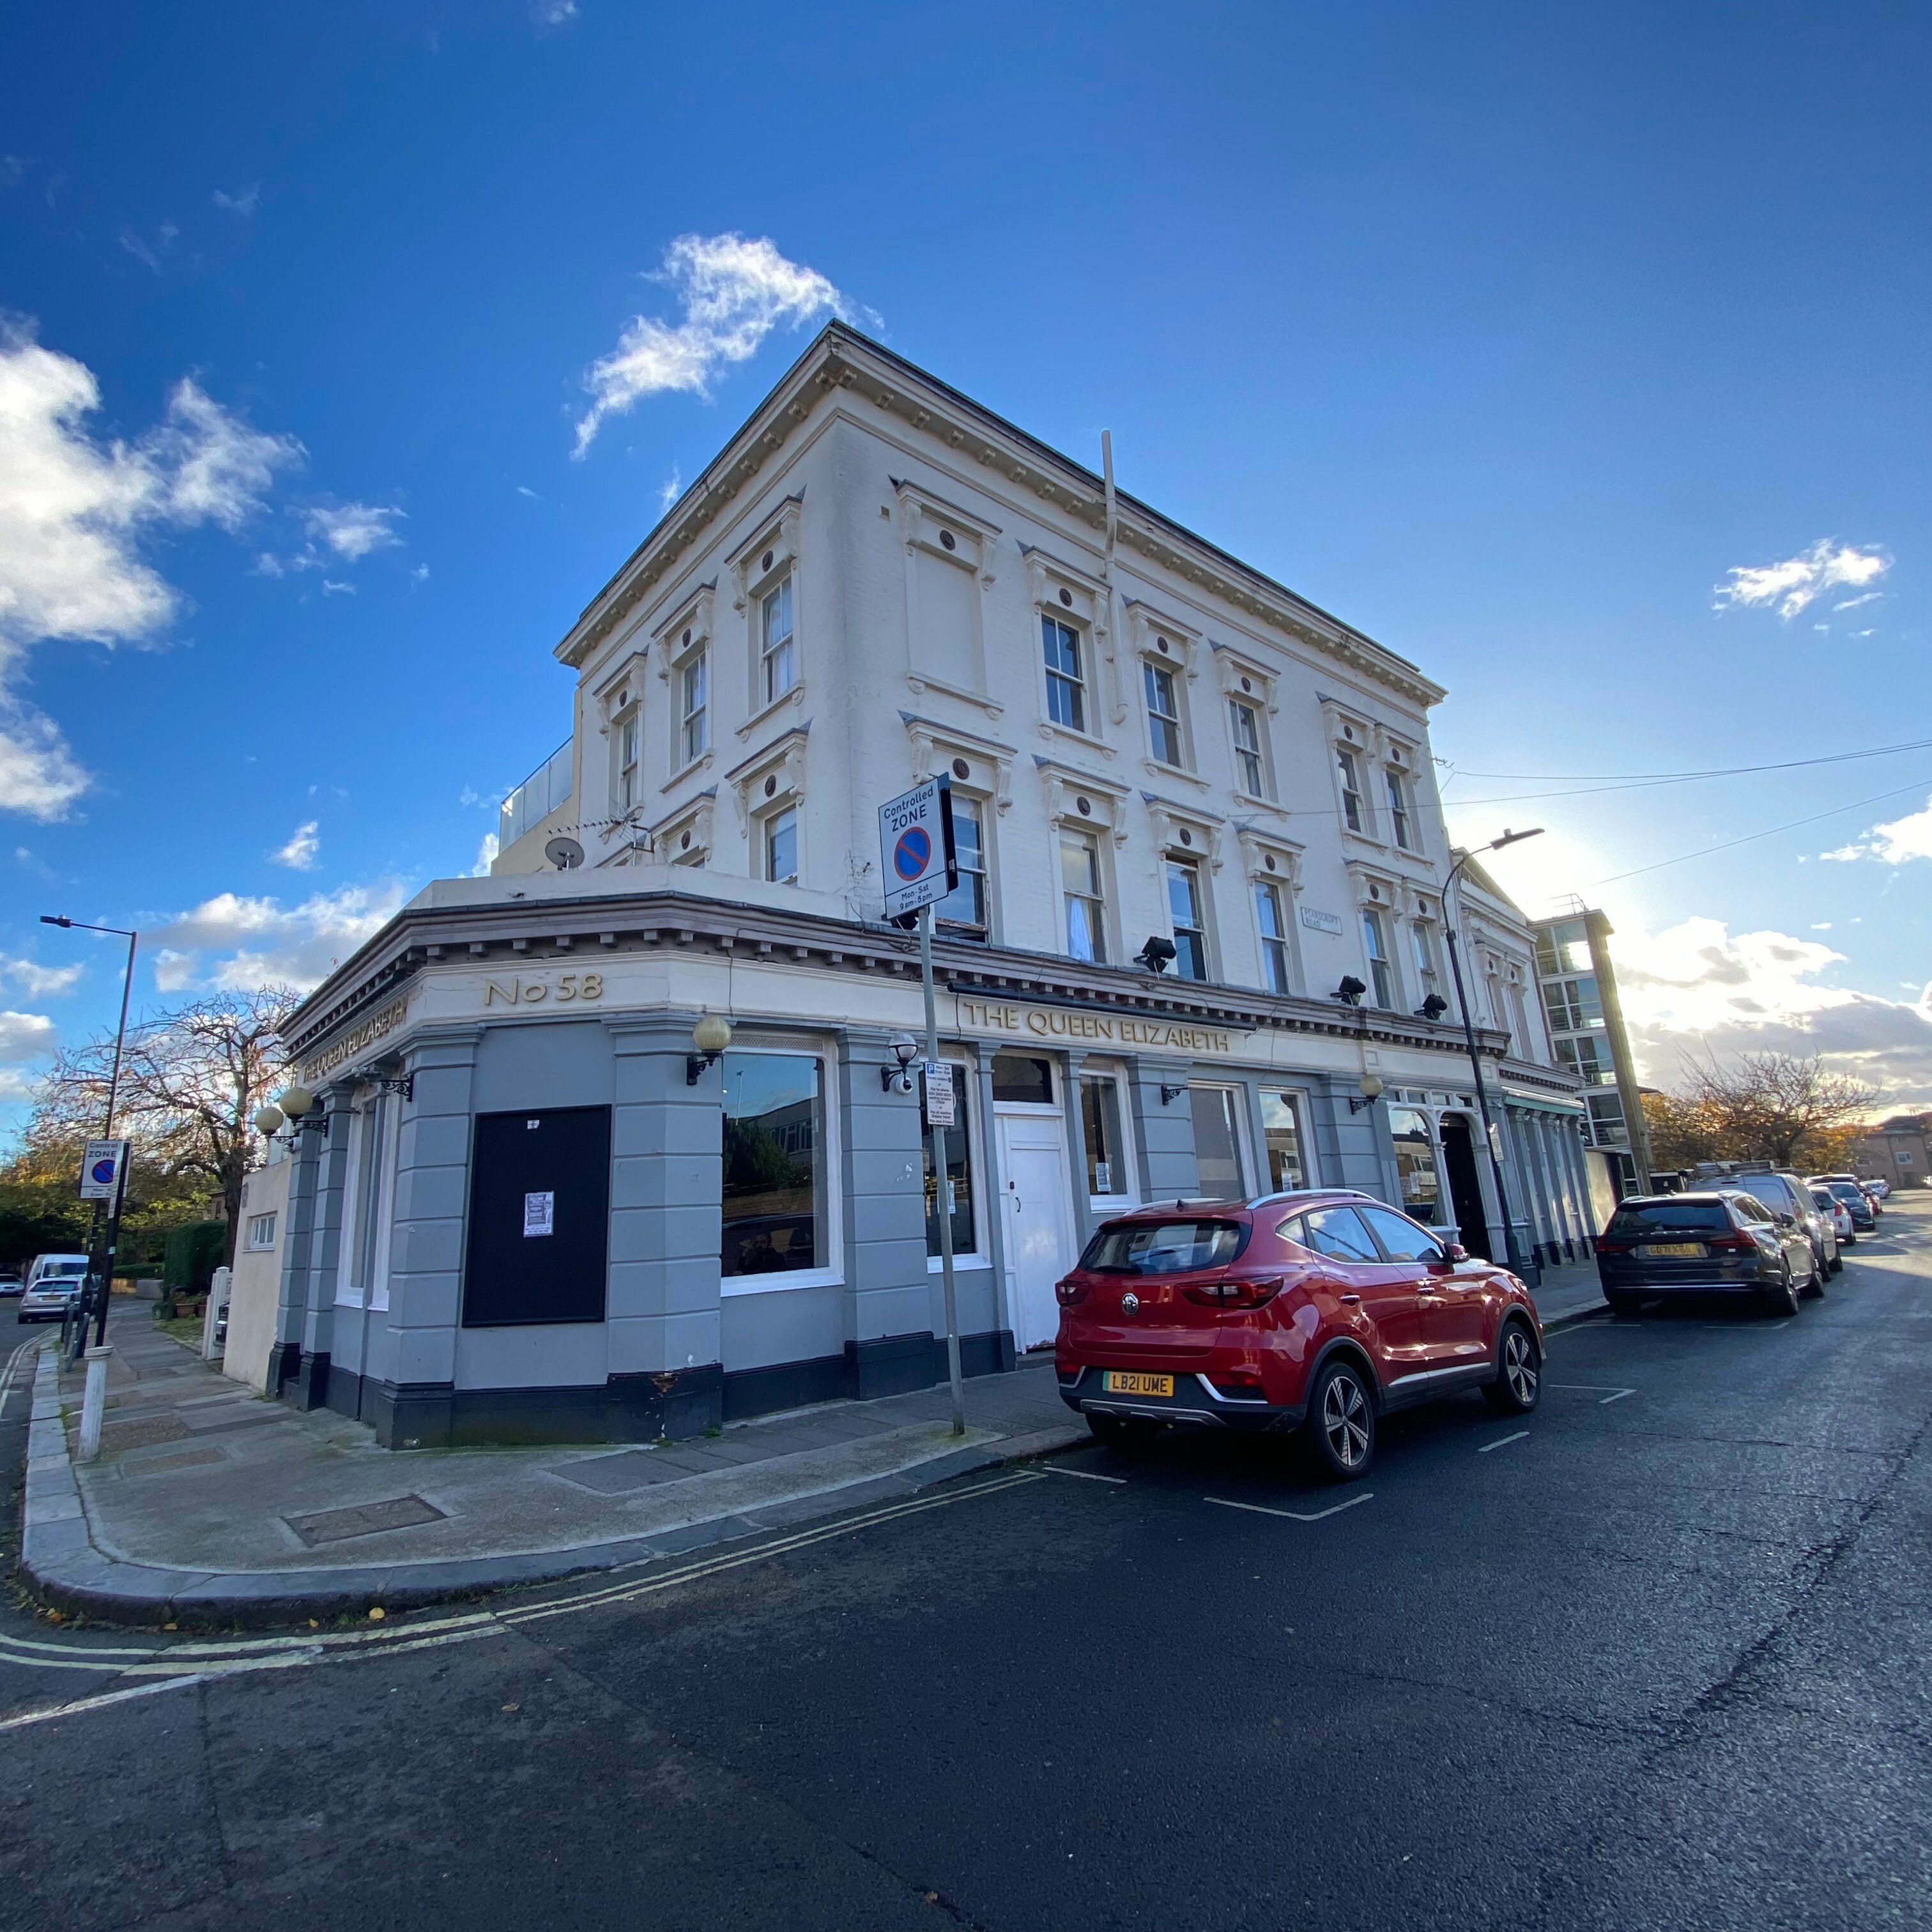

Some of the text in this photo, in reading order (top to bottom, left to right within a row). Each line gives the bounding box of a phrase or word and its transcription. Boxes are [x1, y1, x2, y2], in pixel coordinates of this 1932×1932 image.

[884, 785, 933, 819] Controlled
[891, 804, 927, 832] ZONE
[484, 972, 602, 1006] No 58
[964, 1002, 1229, 1052] THE QUEEN ELIZABETH
[1112, 1375, 1169, 1393] LB21 UME
